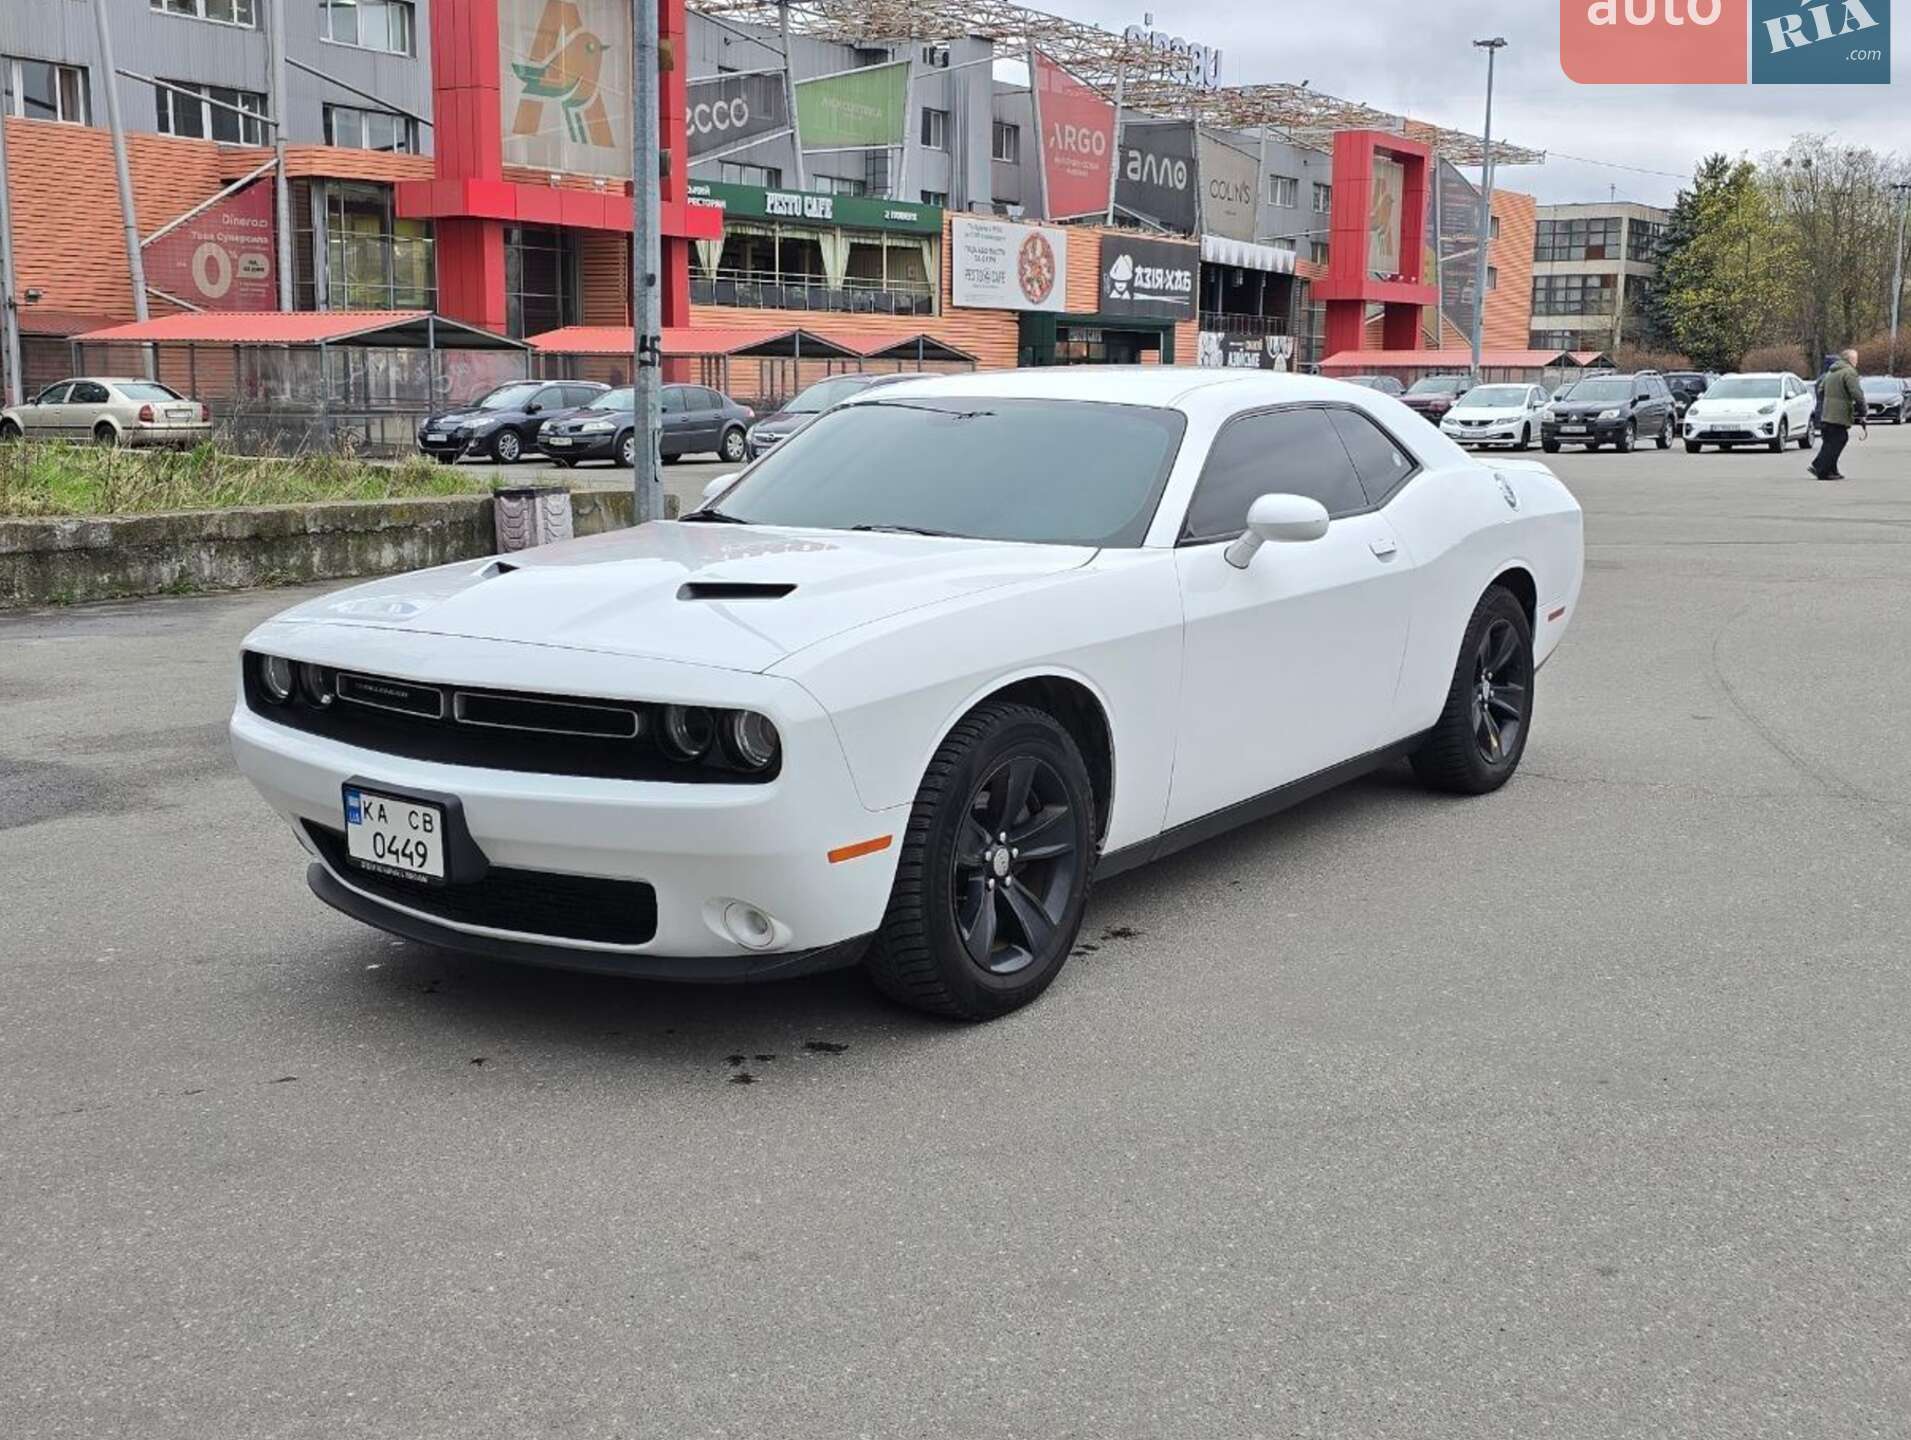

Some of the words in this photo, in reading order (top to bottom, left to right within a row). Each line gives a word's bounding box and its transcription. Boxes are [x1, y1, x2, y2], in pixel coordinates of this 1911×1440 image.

[1050, 121, 1106, 156] ARGO
[765, 191, 801, 217] PESTO
[803, 195, 833, 219] CAFE
[363, 800, 388, 824] KA
[408, 810, 434, 833] CB
[373, 831, 428, 868] 0449
